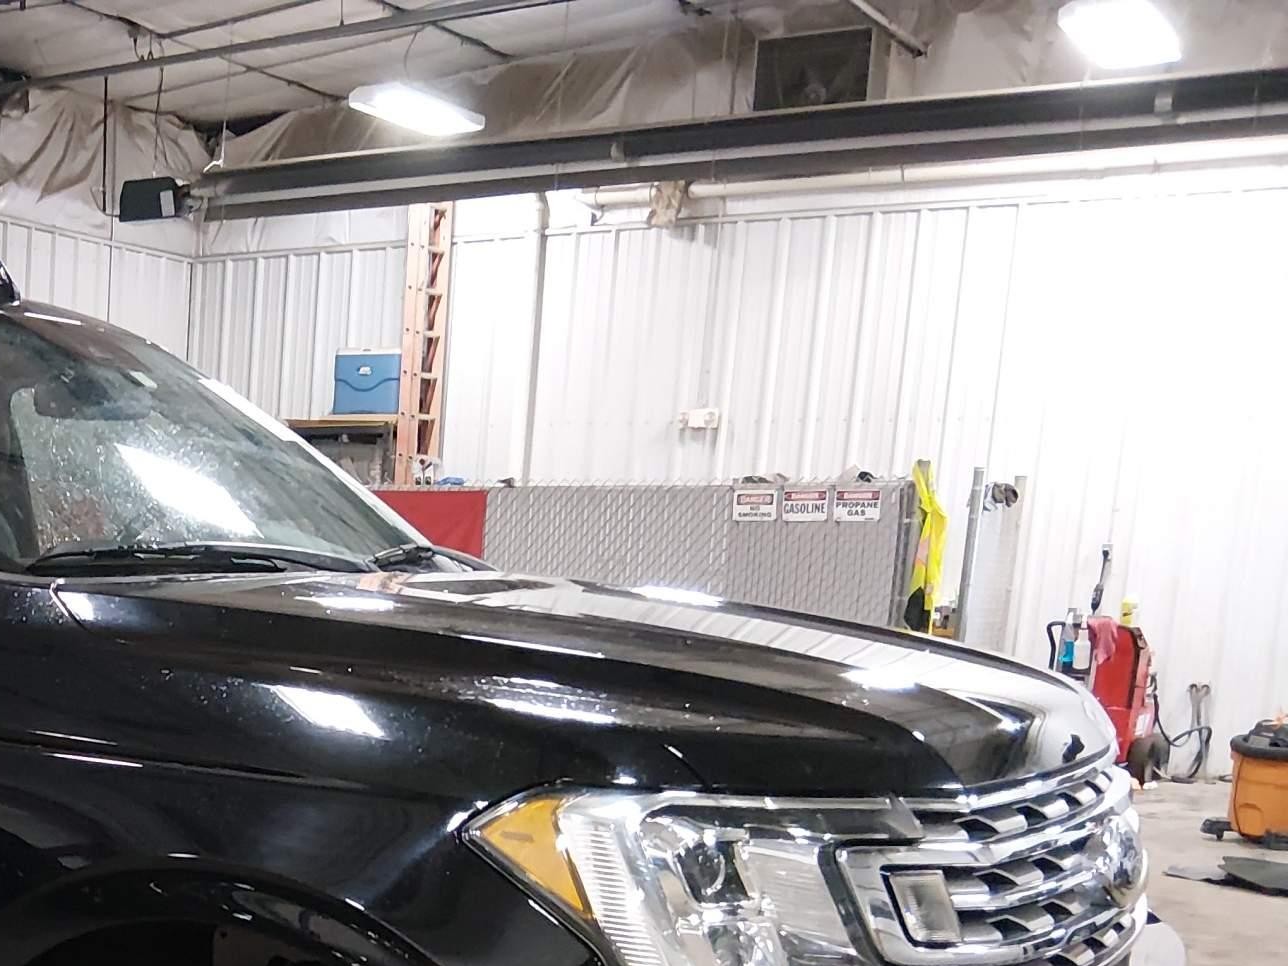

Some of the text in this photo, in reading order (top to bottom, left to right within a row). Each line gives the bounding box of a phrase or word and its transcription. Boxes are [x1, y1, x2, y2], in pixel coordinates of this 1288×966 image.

[783, 503, 826, 514] GASOLINE
[835, 501, 879, 509] PROPANE
[847, 509, 866, 517] GAS
